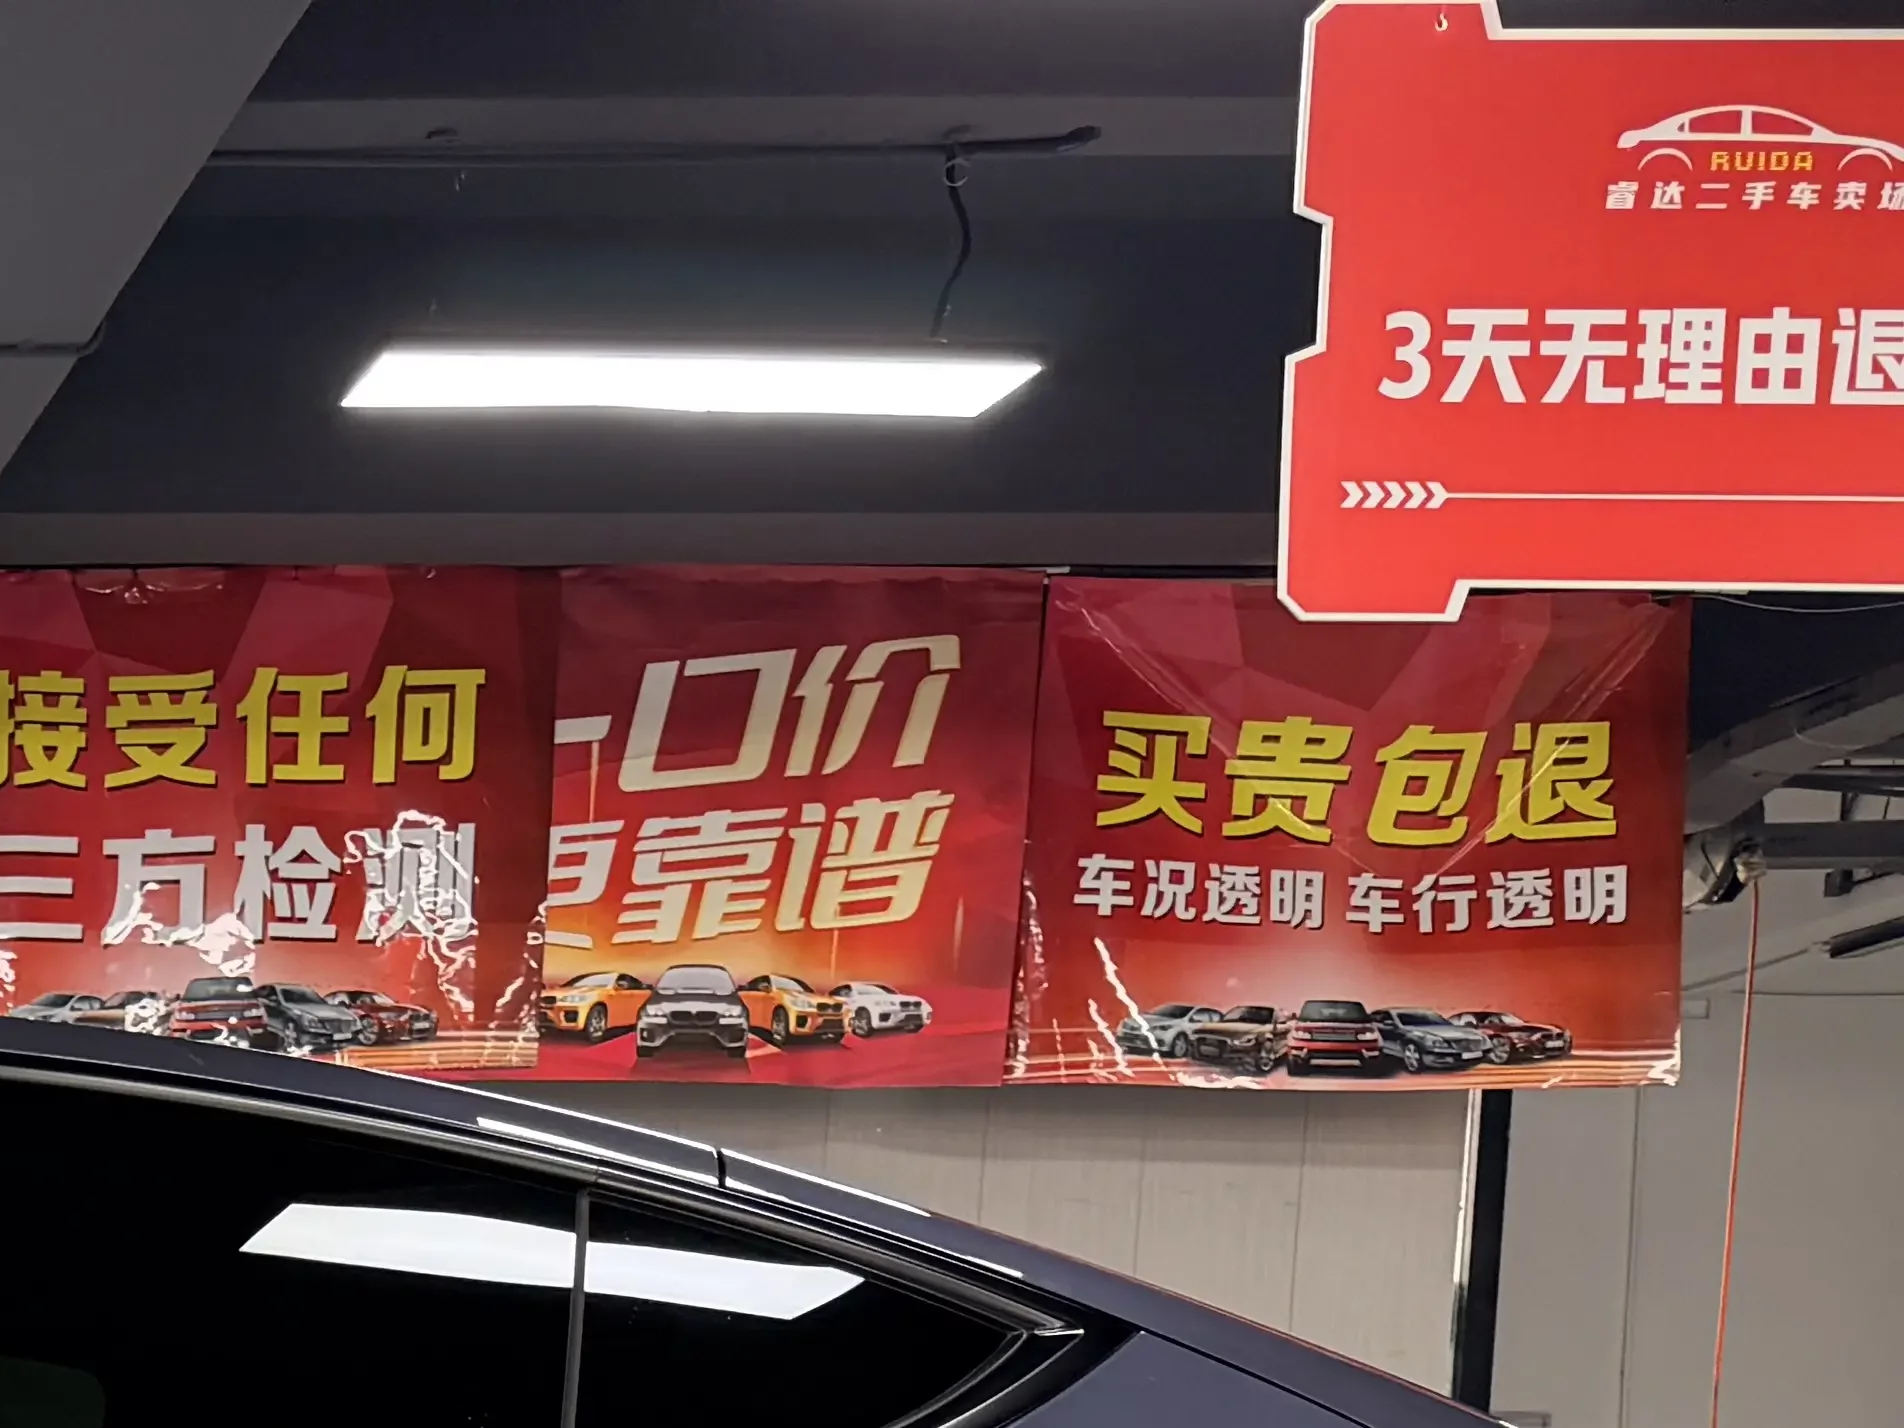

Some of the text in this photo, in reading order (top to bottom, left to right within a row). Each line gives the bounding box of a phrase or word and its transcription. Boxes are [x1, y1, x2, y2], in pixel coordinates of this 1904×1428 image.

[1605, 180, 1904, 210] 睿达二手车卖场
[1710, 151, 1814, 171] RUIDA
[1377, 307, 1904, 406] 3天无理由退
[1096, 710, 1617, 845] 买贵包退
[1073, 853, 1627, 933] 车况透明 车行透明
